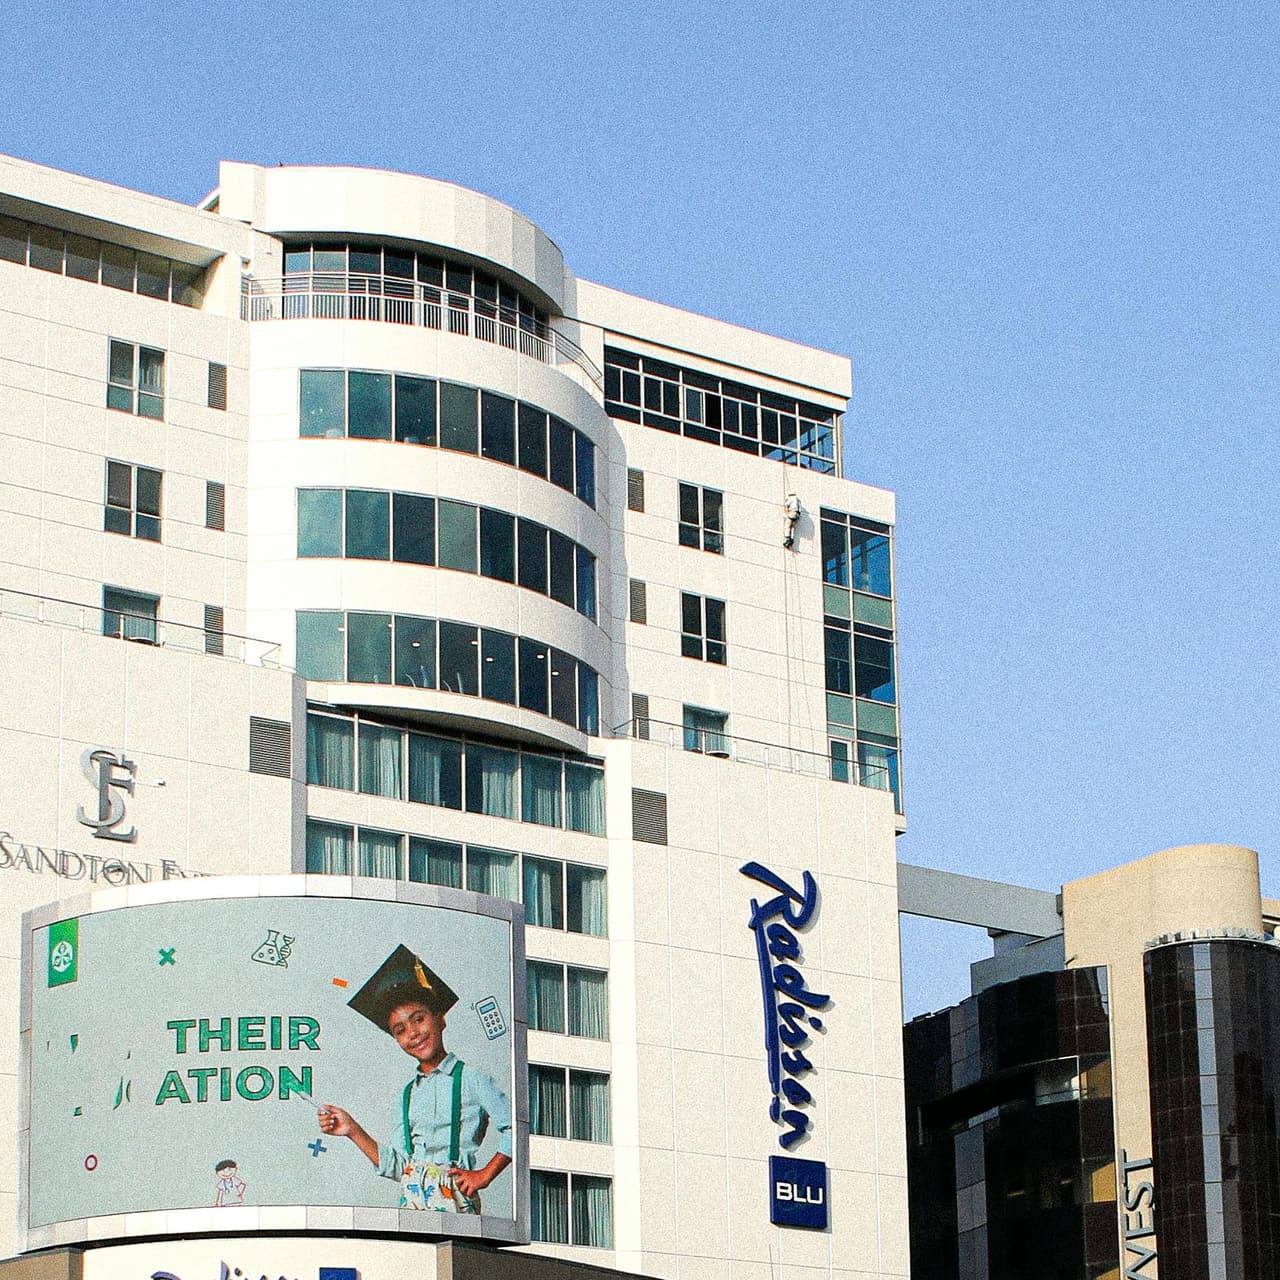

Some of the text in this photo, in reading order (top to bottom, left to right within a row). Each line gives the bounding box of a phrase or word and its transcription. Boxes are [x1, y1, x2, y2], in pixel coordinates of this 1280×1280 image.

[739, 860, 831, 1150] Radisson
[166, 1015, 322, 1055] THEIR
[775, 1180, 824, 1205] BLU
